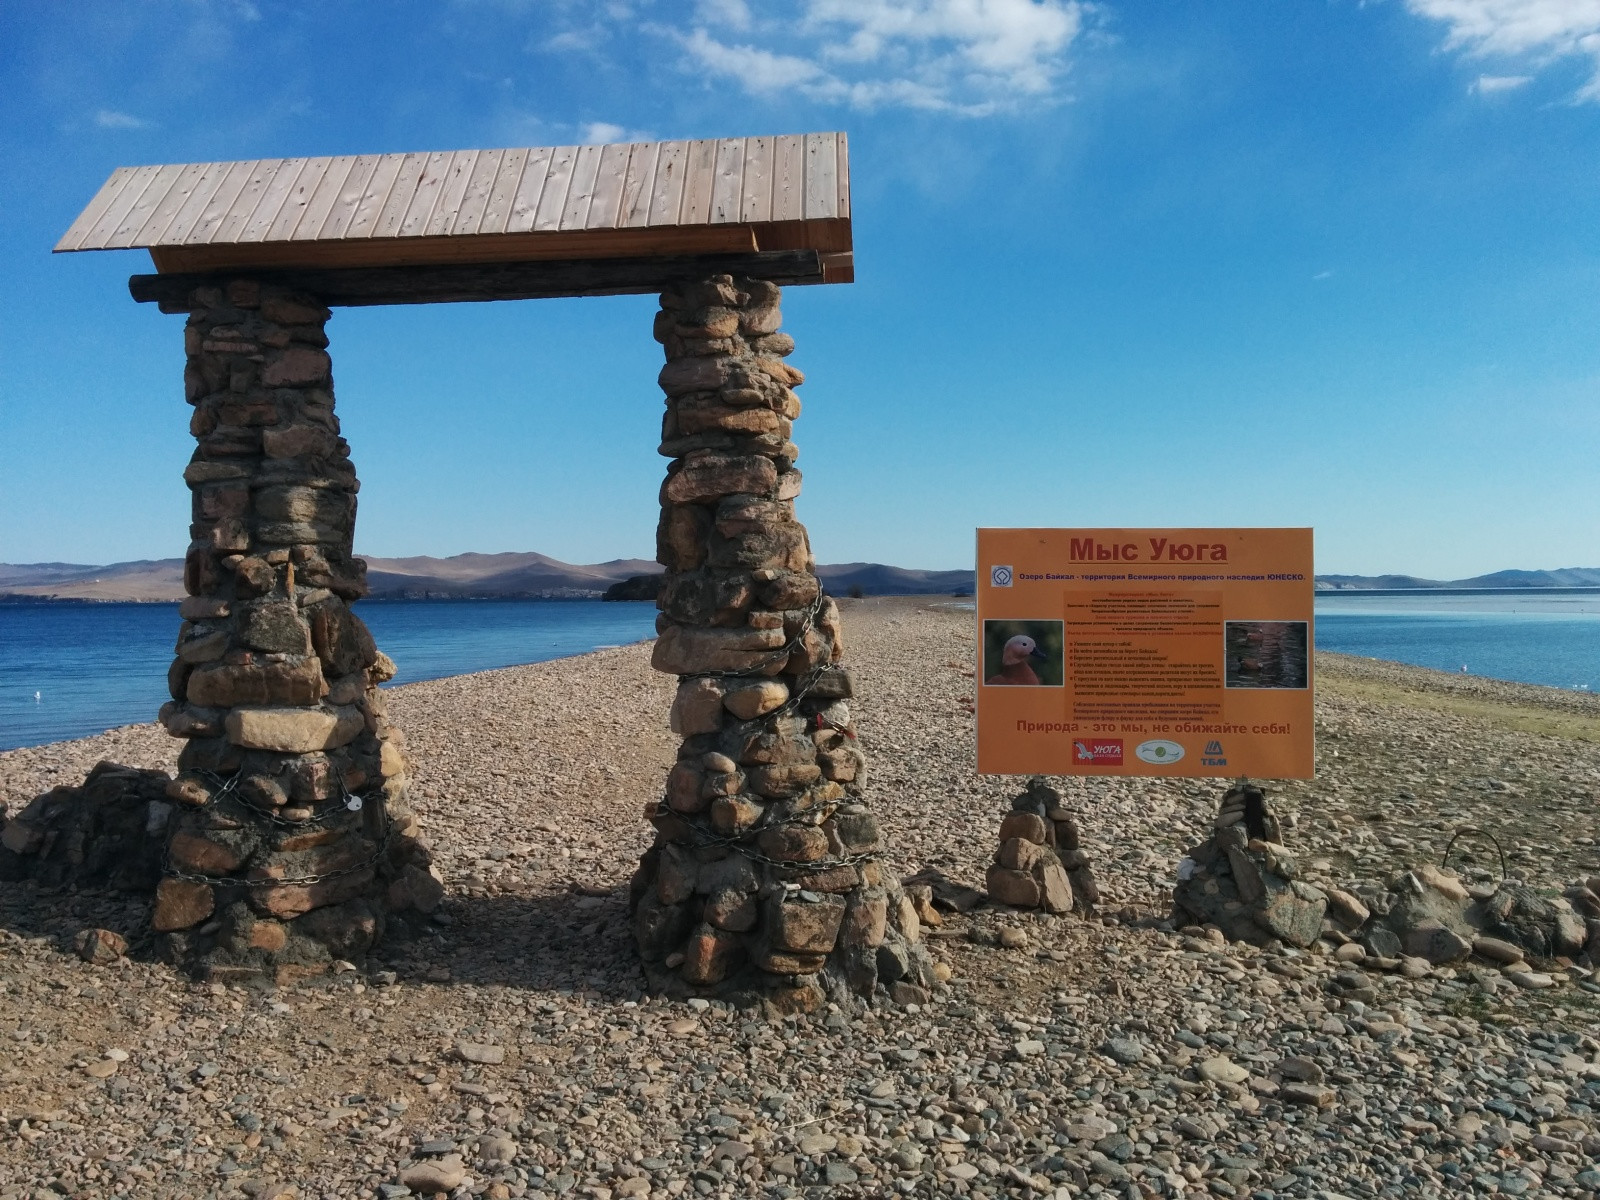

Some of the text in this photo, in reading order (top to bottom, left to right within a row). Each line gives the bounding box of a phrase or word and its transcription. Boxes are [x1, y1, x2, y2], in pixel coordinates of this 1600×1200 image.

[1070, 538, 1227, 561] Мыс Уюга
[1019, 573, 1044, 581] Озеро
[1081, 574, 1126, 582] территория
[1127, 574, 1176, 582] Всемирного
[1267, 573, 1306, 581] ЮНЕСКО.
[1016, 720, 1079, 733] Природа
[1093, 723, 1116, 732] это
[1121, 724, 1147, 734] мы,
[1152, 724, 1170, 733] не
[1174, 722, 1247, 734] обижайте
[1251, 723, 1291, 734] себя!
[1094, 745, 1122, 754] УЮГА
[1201, 758, 1227, 766] ТБМ
